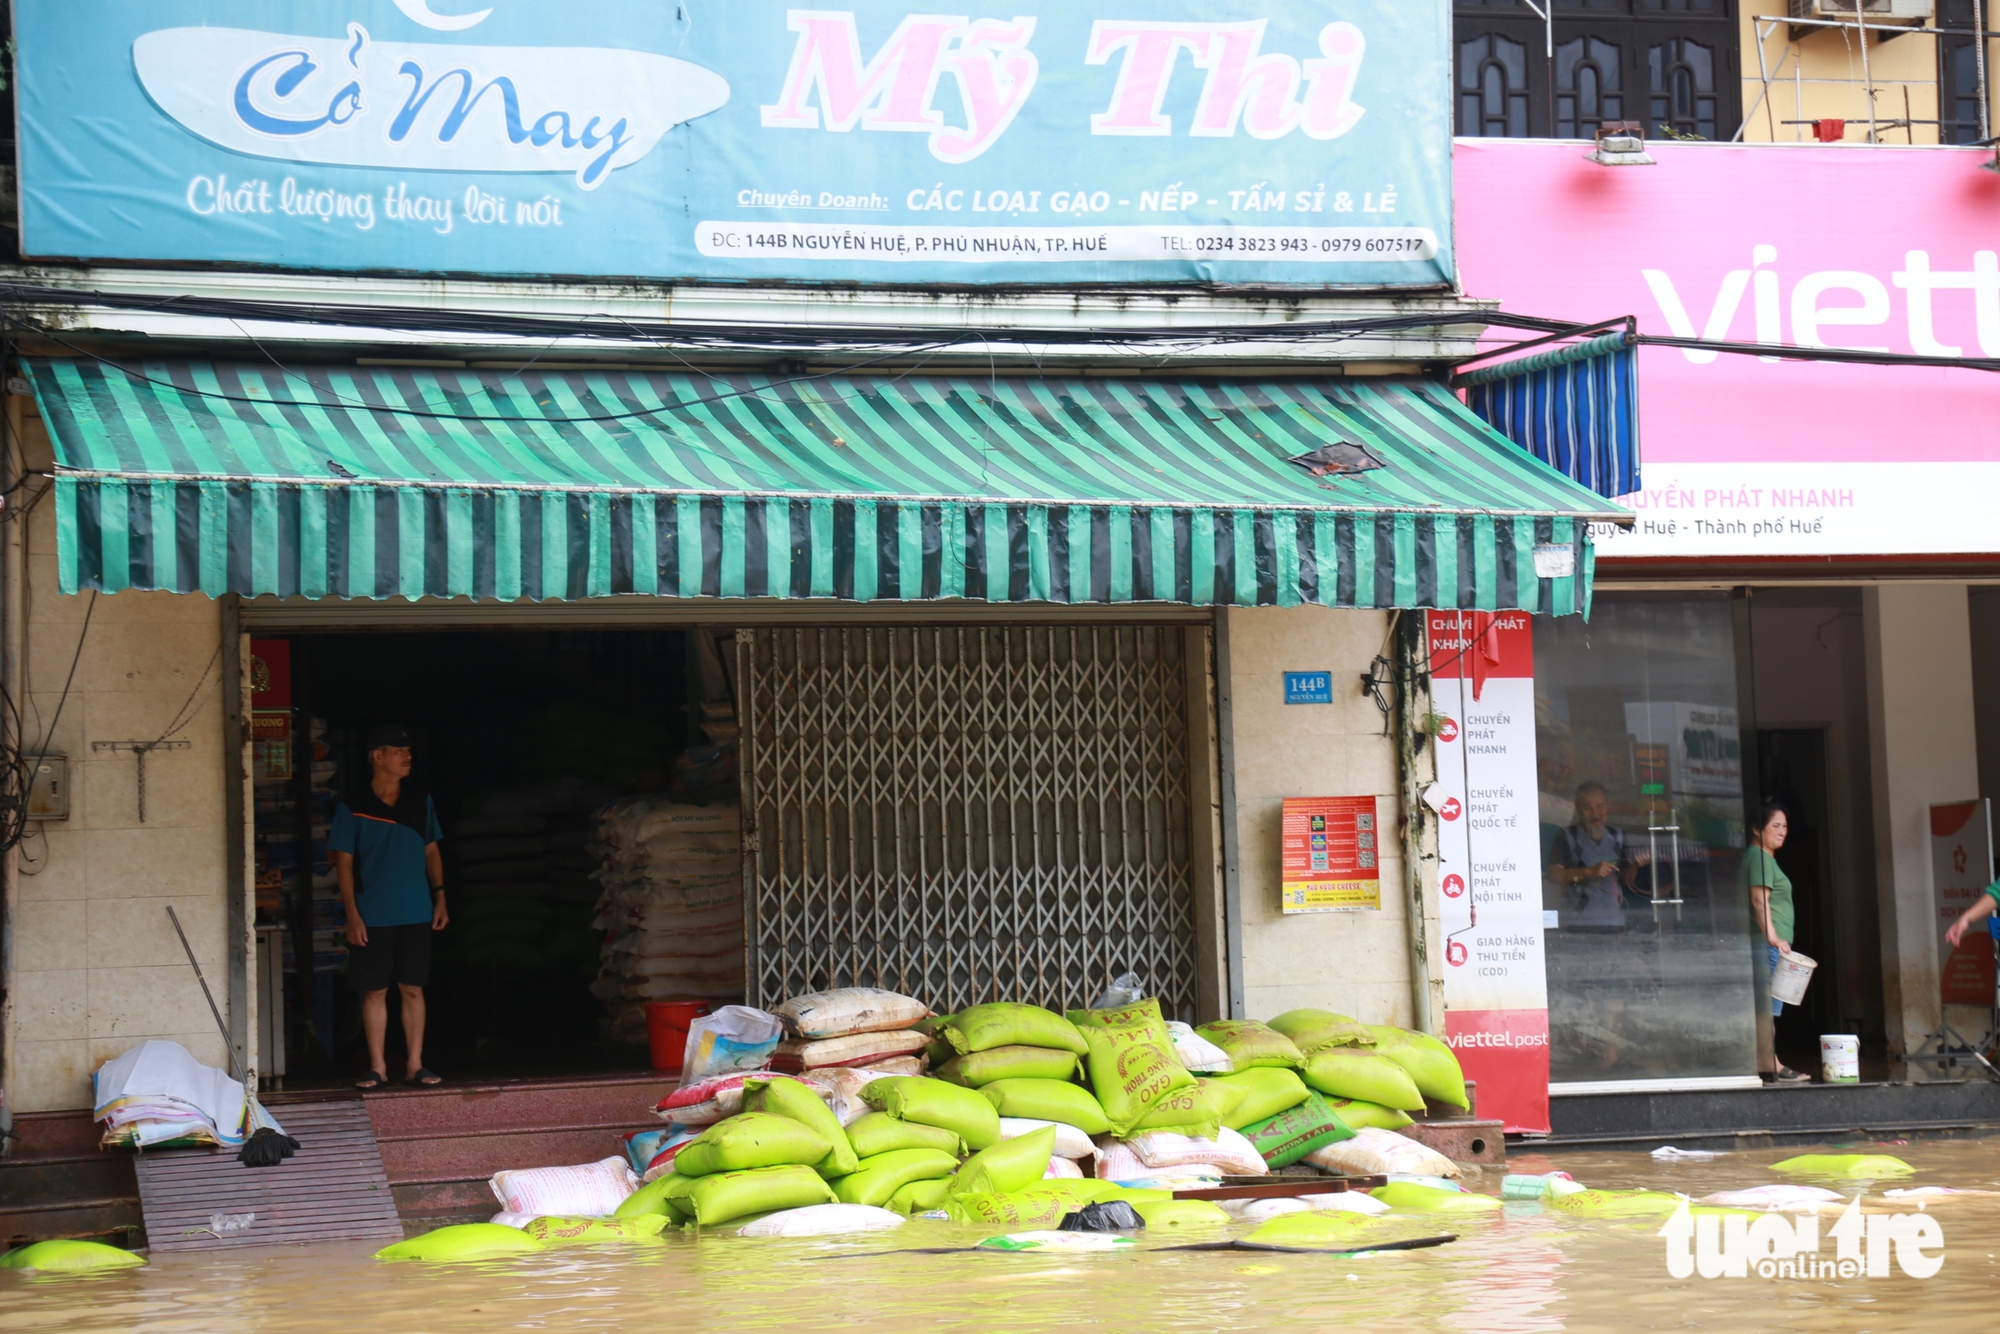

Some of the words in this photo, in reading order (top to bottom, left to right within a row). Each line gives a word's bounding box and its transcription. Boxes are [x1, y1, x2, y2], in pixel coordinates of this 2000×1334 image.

[760, 9, 1038, 164] Mỹ
[1084, 18, 1366, 140] Thi
[232, 24, 366, 136] Cỏ
[387, 60, 636, 186] May
[187, 175, 272, 215] Chất
[279, 176, 376, 230] lượng
[384, 182, 453, 235] thay
[463, 185, 508, 224] lời
[516, 195, 563, 225] nói
[737, 189, 812, 209] Chuyên
[818, 191, 889, 209] Doanh:
[906, 182, 964, 212] CÁC
[972, 190, 1042, 217] LOẠI
[1050, 190, 1110, 217] GẠO
[1139, 182, 1198, 212] NẾP
[1228, 181, 1286, 212] TẤM
[1294, 183, 1326, 213] SỈ
[1333, 192, 1354, 213] &
[1363, 183, 1398, 213] LẺ
[712, 232, 741, 248] ĐC:
[746, 233, 788, 248] 144B
[792, 230, 865, 250] NGUYỄN
[871, 235, 911, 255] HUỆ,
[915, 237, 928, 250] P.
[932, 235, 967, 251] PHÚ
[973, 235, 1041, 255] NHUẬN,
[1045, 238, 1068, 251] TP.
[1073, 233, 1107, 250] HUẾ
[1161, 236, 1192, 250] TEL:
[1196, 237, 1234, 251] 0234
[1238, 238, 1276, 251] 3823
[1280, 238, 1308, 251] 943
[1321, 238, 1361, 252] 0979
[1365, 237, 1423, 252] 607517
[1704, 483, 1763, 509] PHÁT
[1772, 489, 1854, 508] NHANH
[1644, 520, 1677, 538] Huệ
[1695, 518, 1747, 534] Thành
[1753, 516, 1785, 537] phố
[1790, 516, 1824, 534] Huế
[1433, 639, 1472, 650] NHAN
[1291, 677, 1326, 692] 144B
[1467, 711, 1511, 725] CHUYỂN
[1468, 728, 1496, 739] PHÁT
[1468, 745, 1507, 754] NHANH
[1470, 785, 1514, 798] CHUYỂN
[1471, 802, 1498, 813] PHÁT
[1471, 814, 1501, 830] QUỐC
[1503, 814, 1518, 827] TẾ
[1473, 858, 1516, 872] CHUYỂN
[1474, 876, 1501, 887] PHÁT
[1474, 890, 1494, 904] NỘI
[1476, 938, 1502, 947] GIAO
[1506, 934, 1535, 948] HÀNG
[1476, 952, 1499, 962] THU
[1502, 948, 1526, 961] TIỀN
[1478, 967, 1508, 977] (COD)
[1445, 1031, 1514, 1048] viettel
[1515, 1032, 1549, 1049] post
